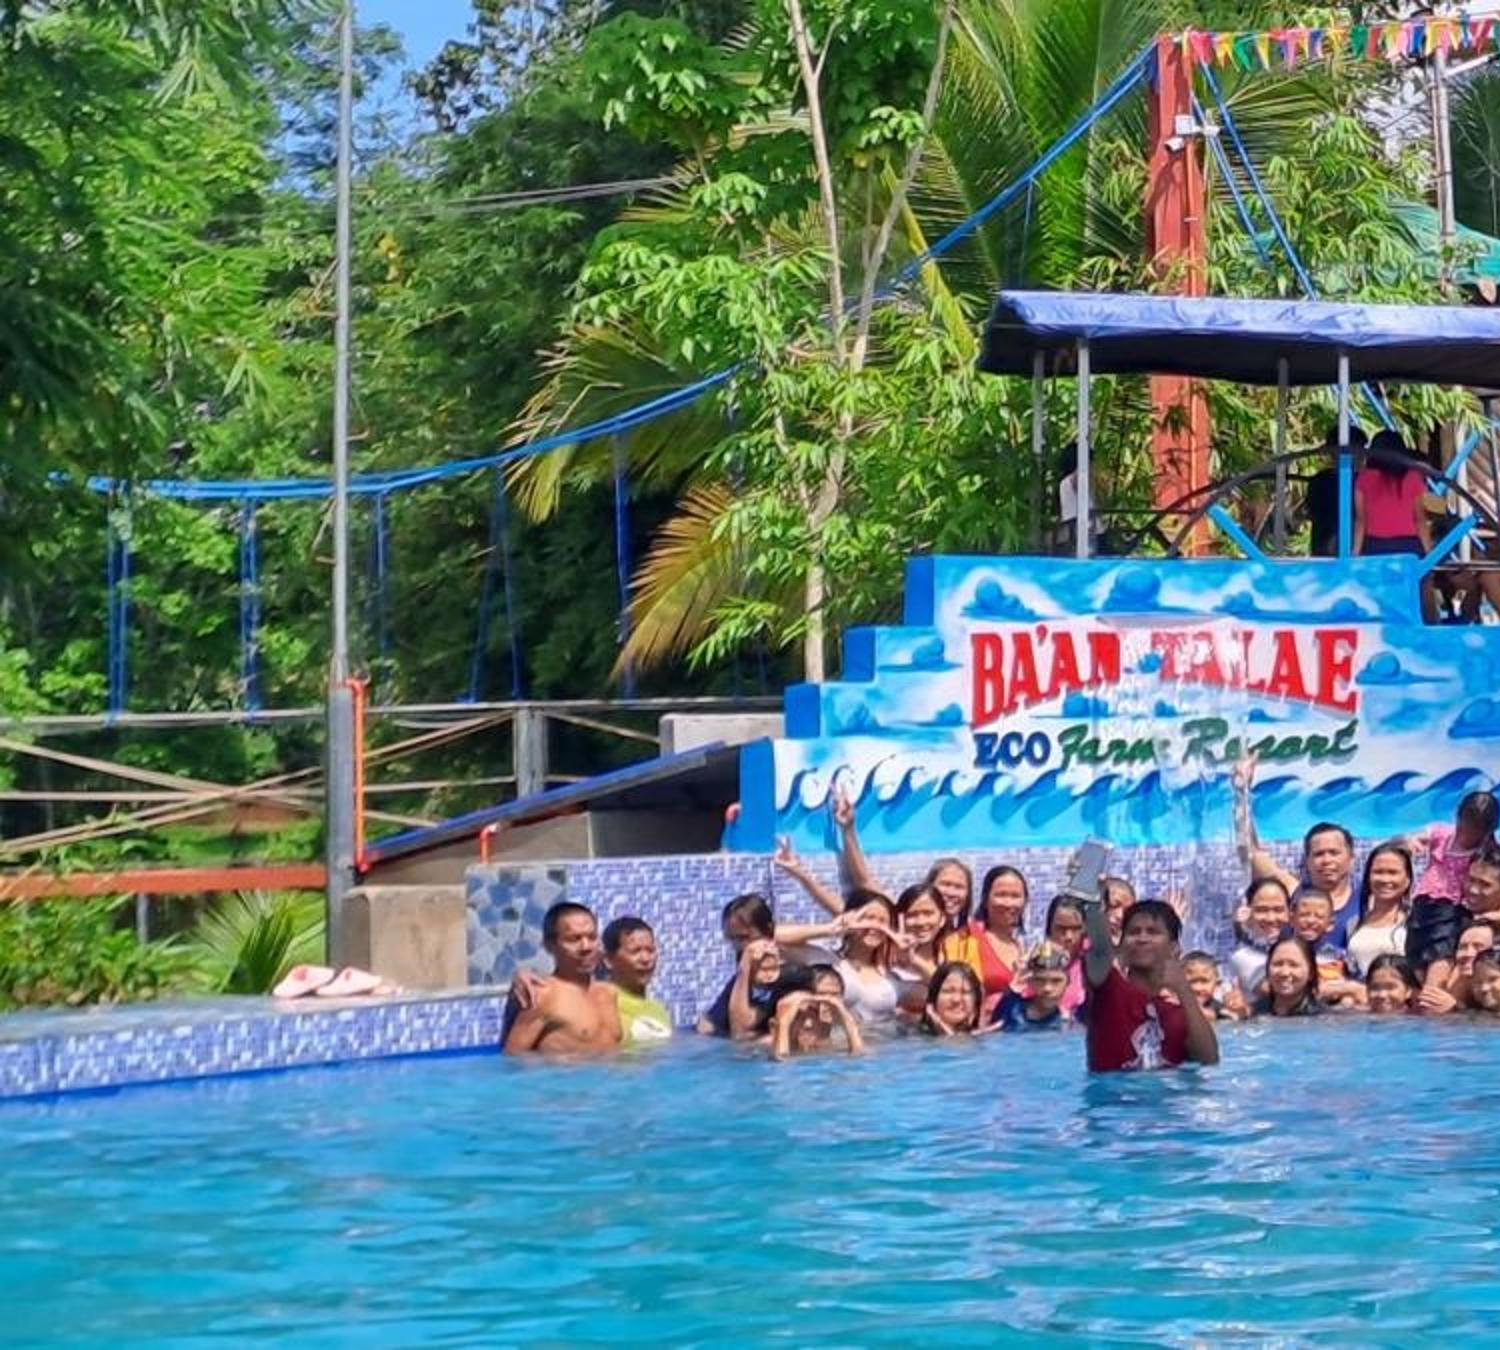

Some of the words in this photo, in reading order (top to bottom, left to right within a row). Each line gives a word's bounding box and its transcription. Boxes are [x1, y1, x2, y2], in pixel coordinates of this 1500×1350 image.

[973, 731, 1052, 768] ECO
[1057, 724, 1170, 770] Farm
[1181, 717, 1358, 766] Resort
